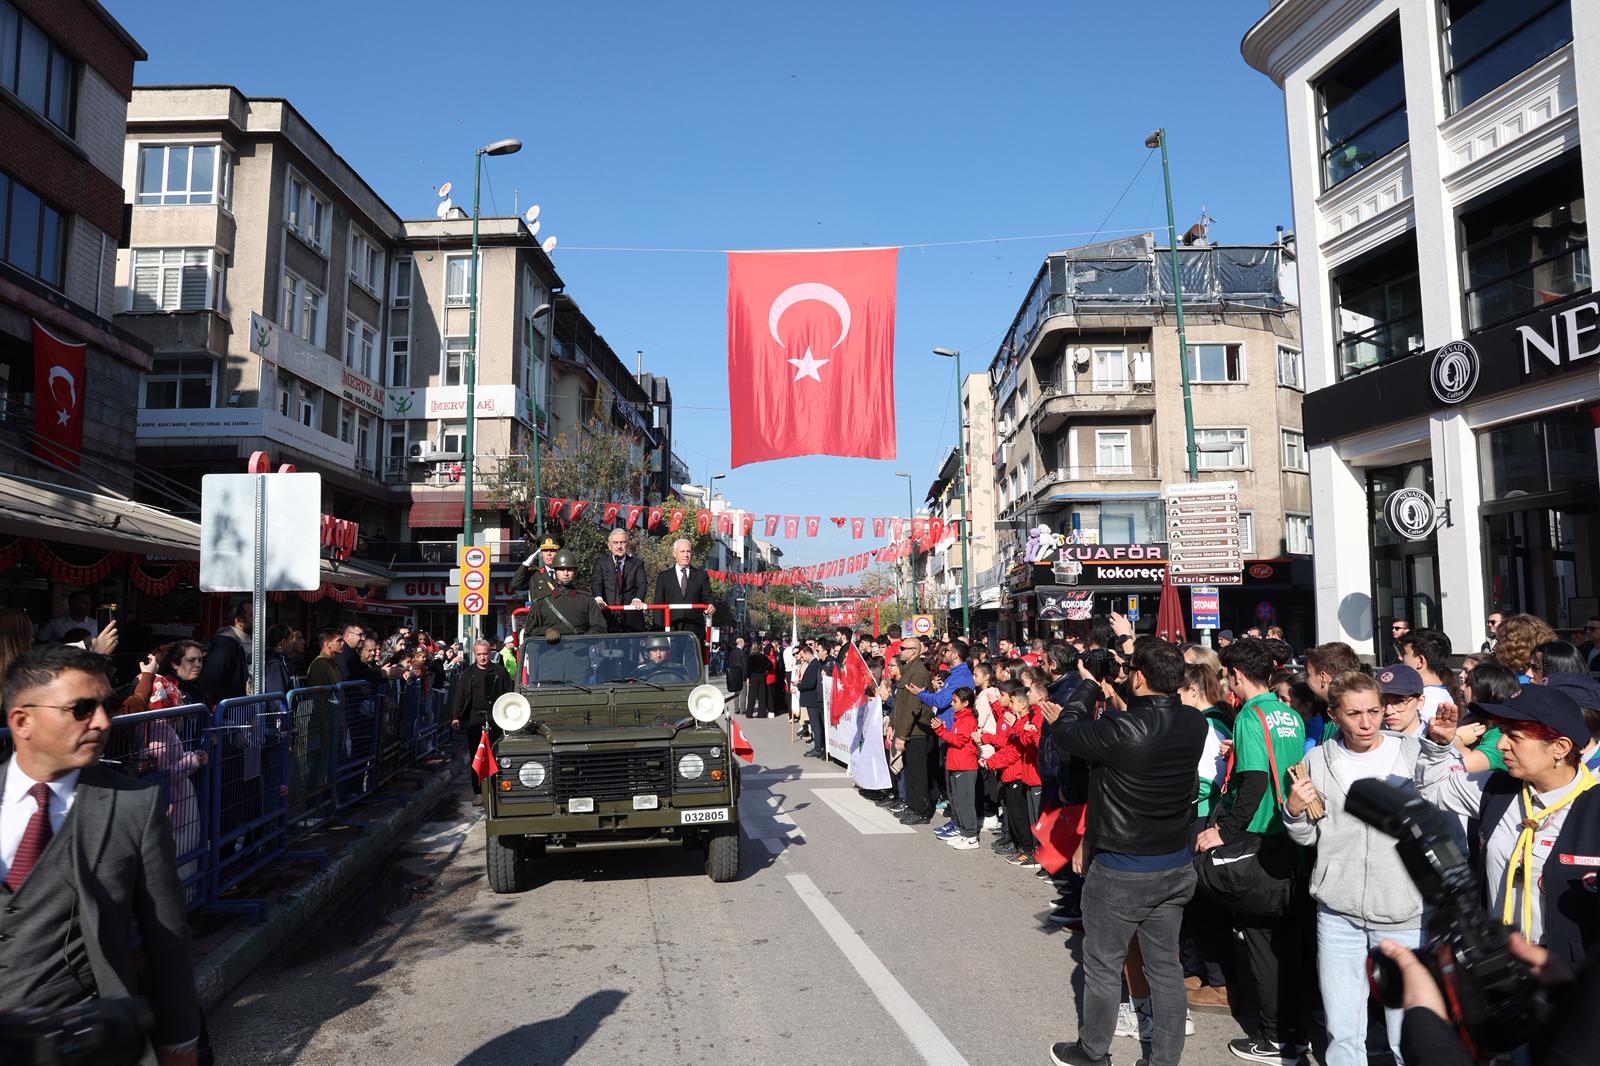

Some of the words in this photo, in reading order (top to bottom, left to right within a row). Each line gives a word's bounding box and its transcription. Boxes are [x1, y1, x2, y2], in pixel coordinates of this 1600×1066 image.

[1440, 345, 1467, 359] NEVADA
[343, 370, 372, 397] MERVE
[373, 388, 384, 404] AK
[1447, 390, 1464, 398] Coffee
[433, 401, 467, 411] MERV
[476, 400, 492, 409] AK
[1400, 491, 1425, 501] NEVADA
[1059, 544, 1161, 560] KUAFÖR
[1193, 600, 1217, 610] OTOPARK
[684, 811, 724, 822] 032805
